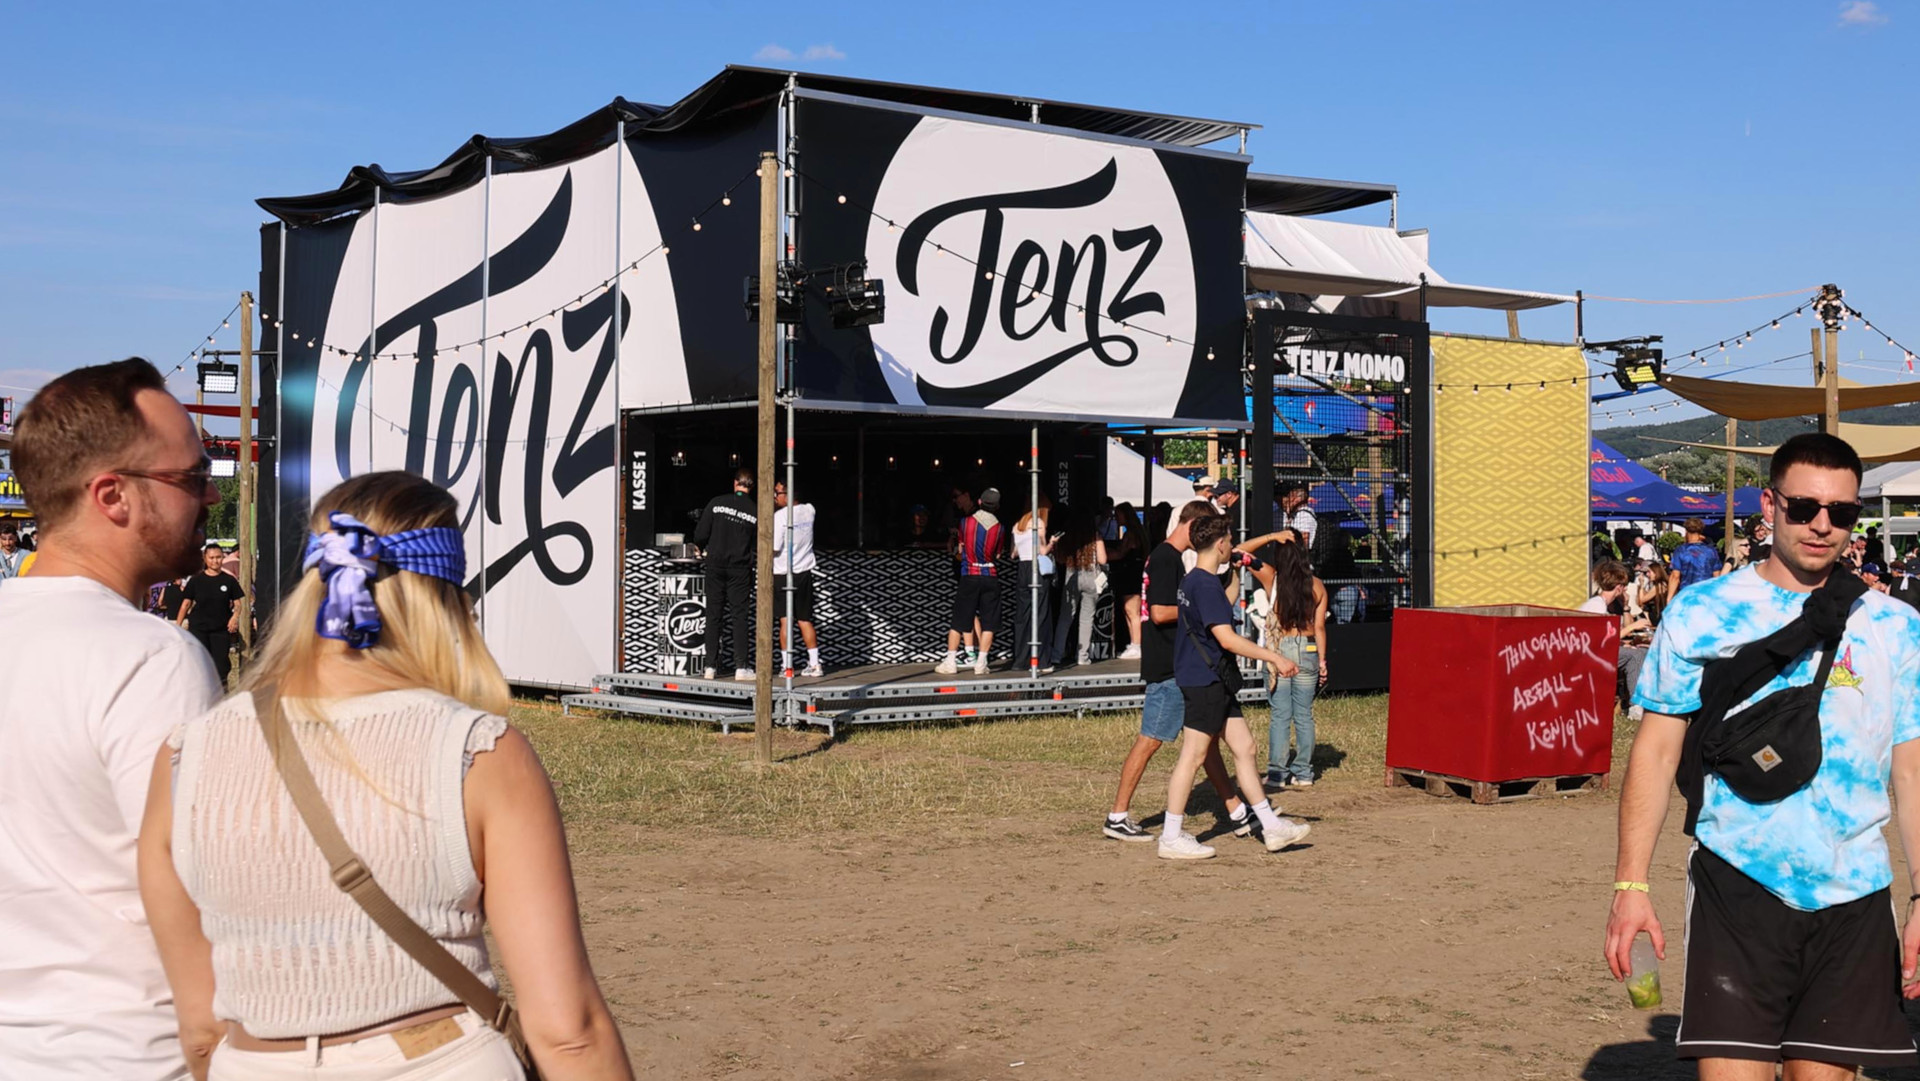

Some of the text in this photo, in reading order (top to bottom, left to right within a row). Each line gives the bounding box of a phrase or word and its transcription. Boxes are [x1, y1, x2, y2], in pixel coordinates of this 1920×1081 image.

[896, 155, 1165, 409] Tenz
[335, 166, 631, 600] Tenz
[1284, 346, 1405, 383] TENZ MOMO
[632, 451, 647, 510] KASSE 1
[1059, 461, 1068, 506] ASSE 2
